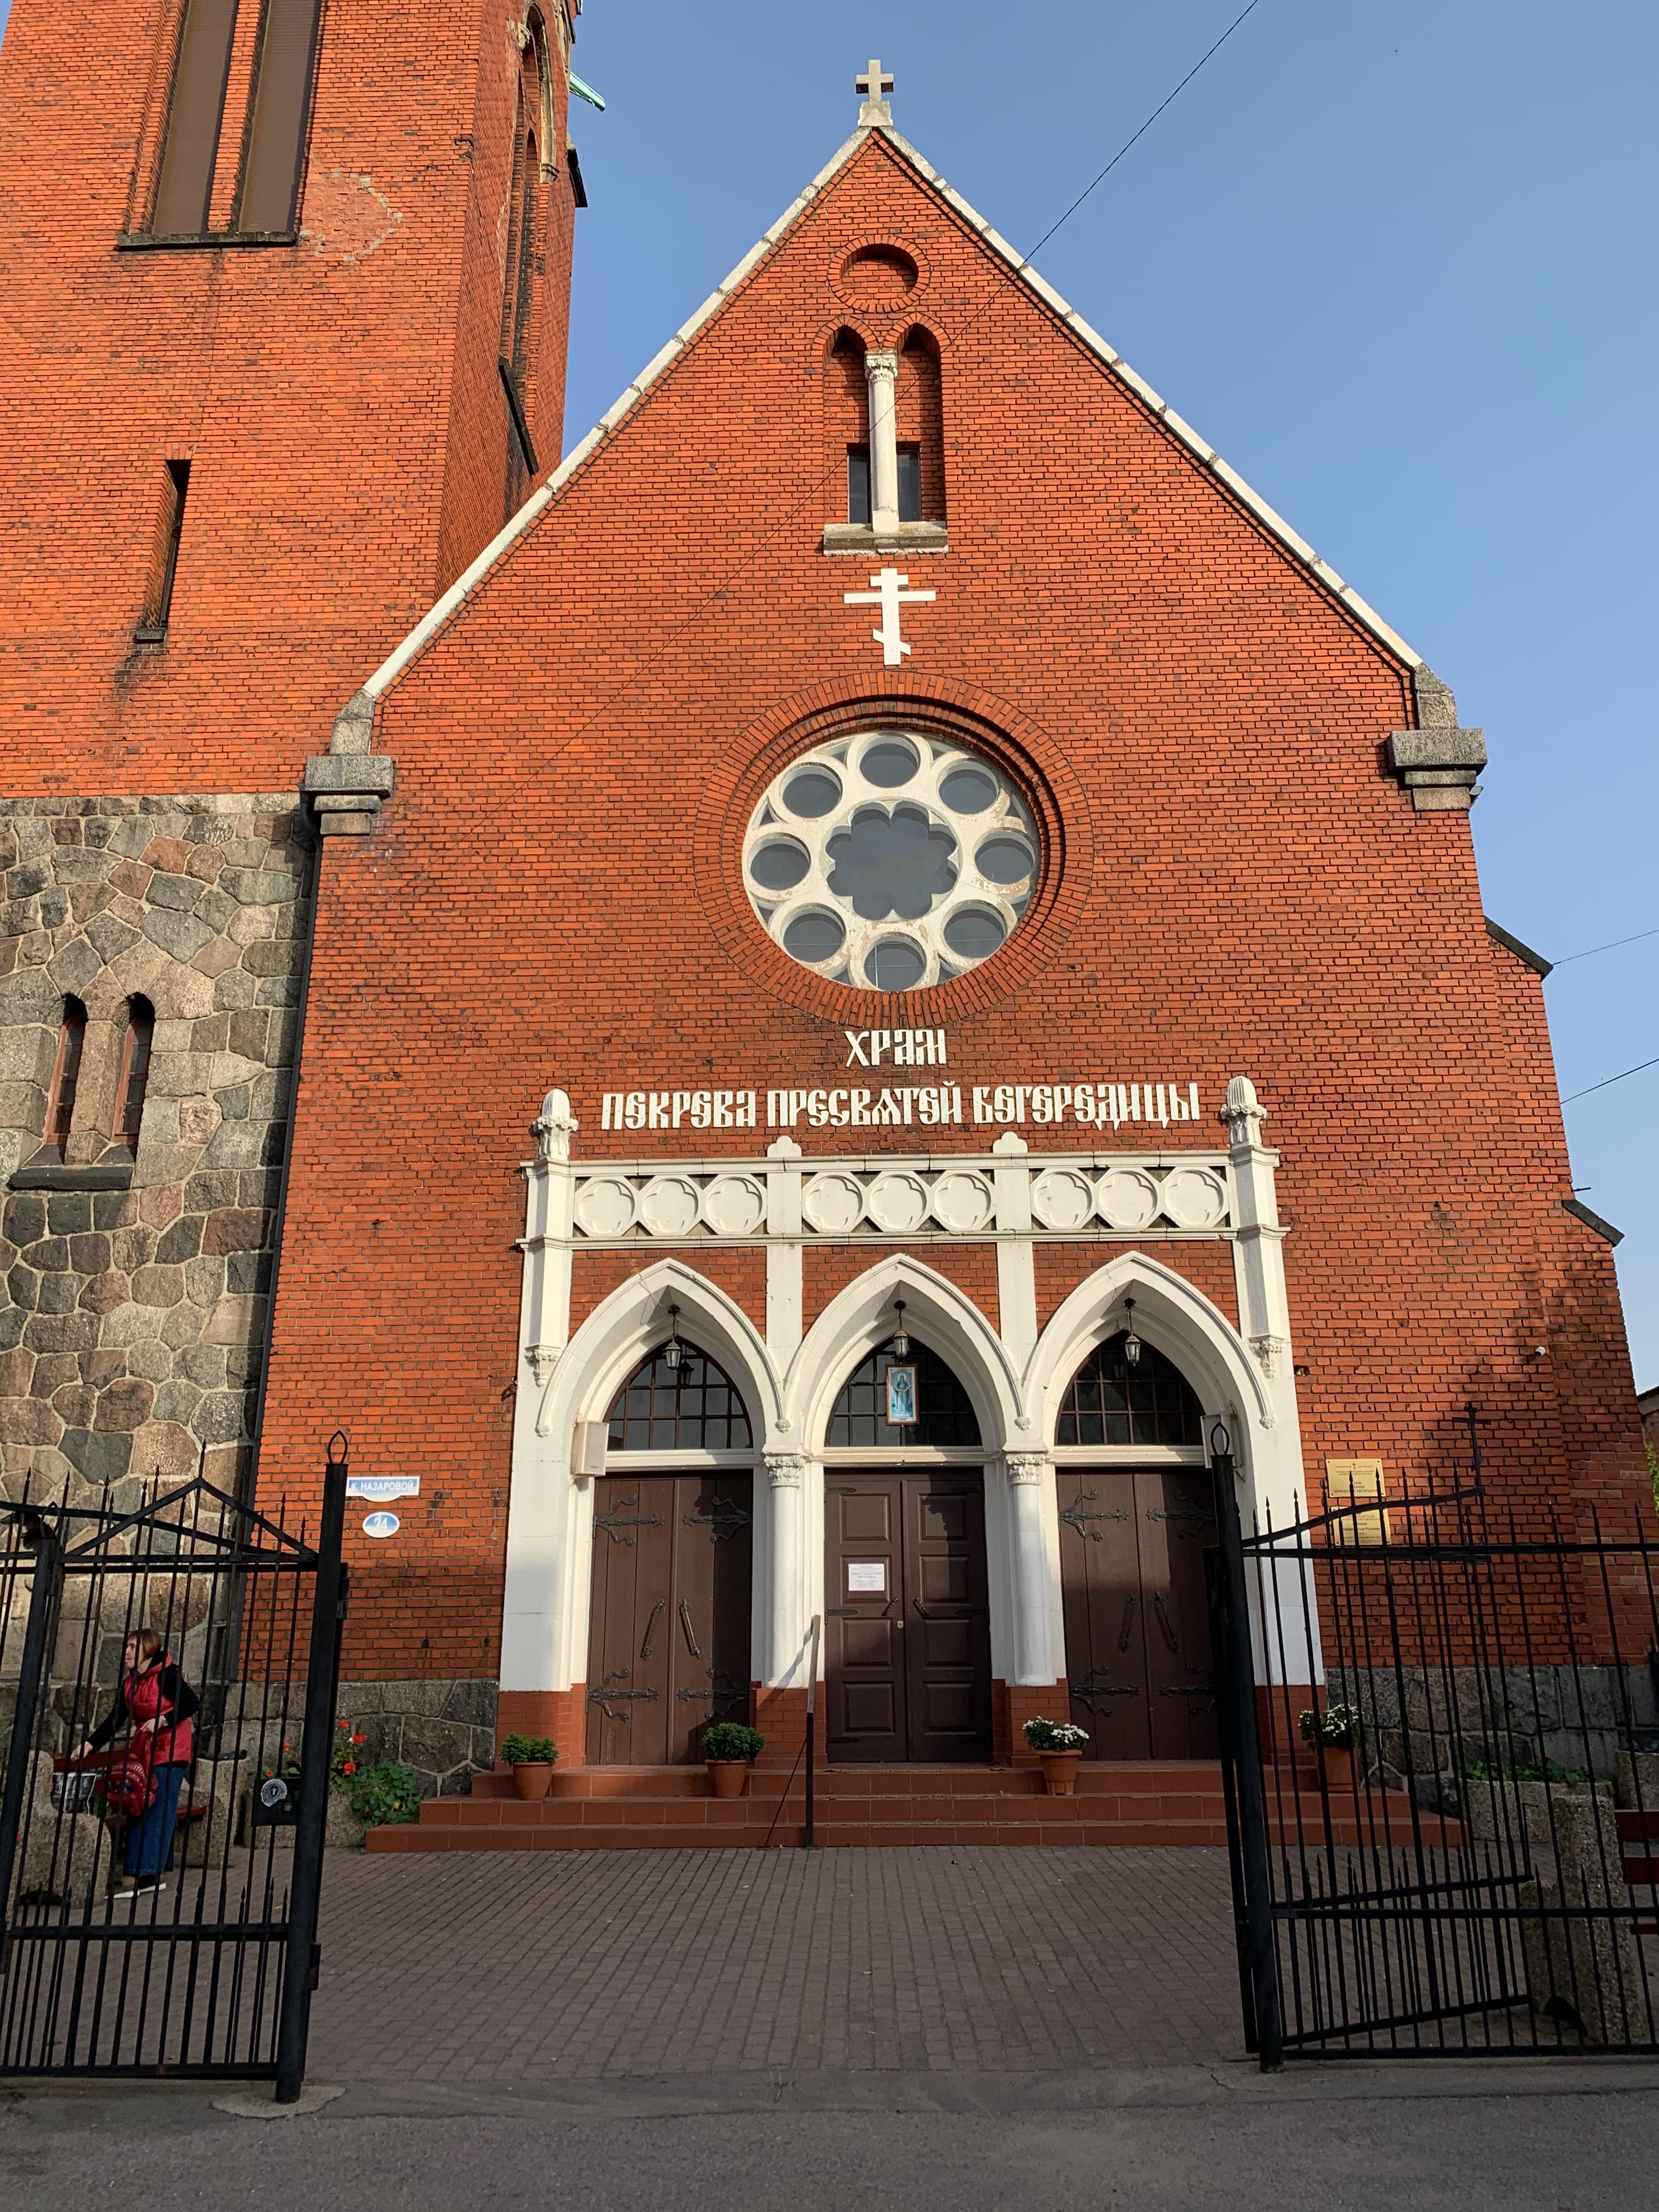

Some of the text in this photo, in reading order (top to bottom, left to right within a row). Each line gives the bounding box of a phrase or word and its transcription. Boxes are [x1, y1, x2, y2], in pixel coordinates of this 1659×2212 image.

[845, 1030, 946, 1066] ХРАМ
[602, 1091, 755, 1130] ПОКРОВА
[973, 1083, 1200, 1130] БОГОРОДИЦЫ
[352, 1480, 414, 1491] К. НАЗАРОВОЙ
[374, 1517, 388, 1531] 24
